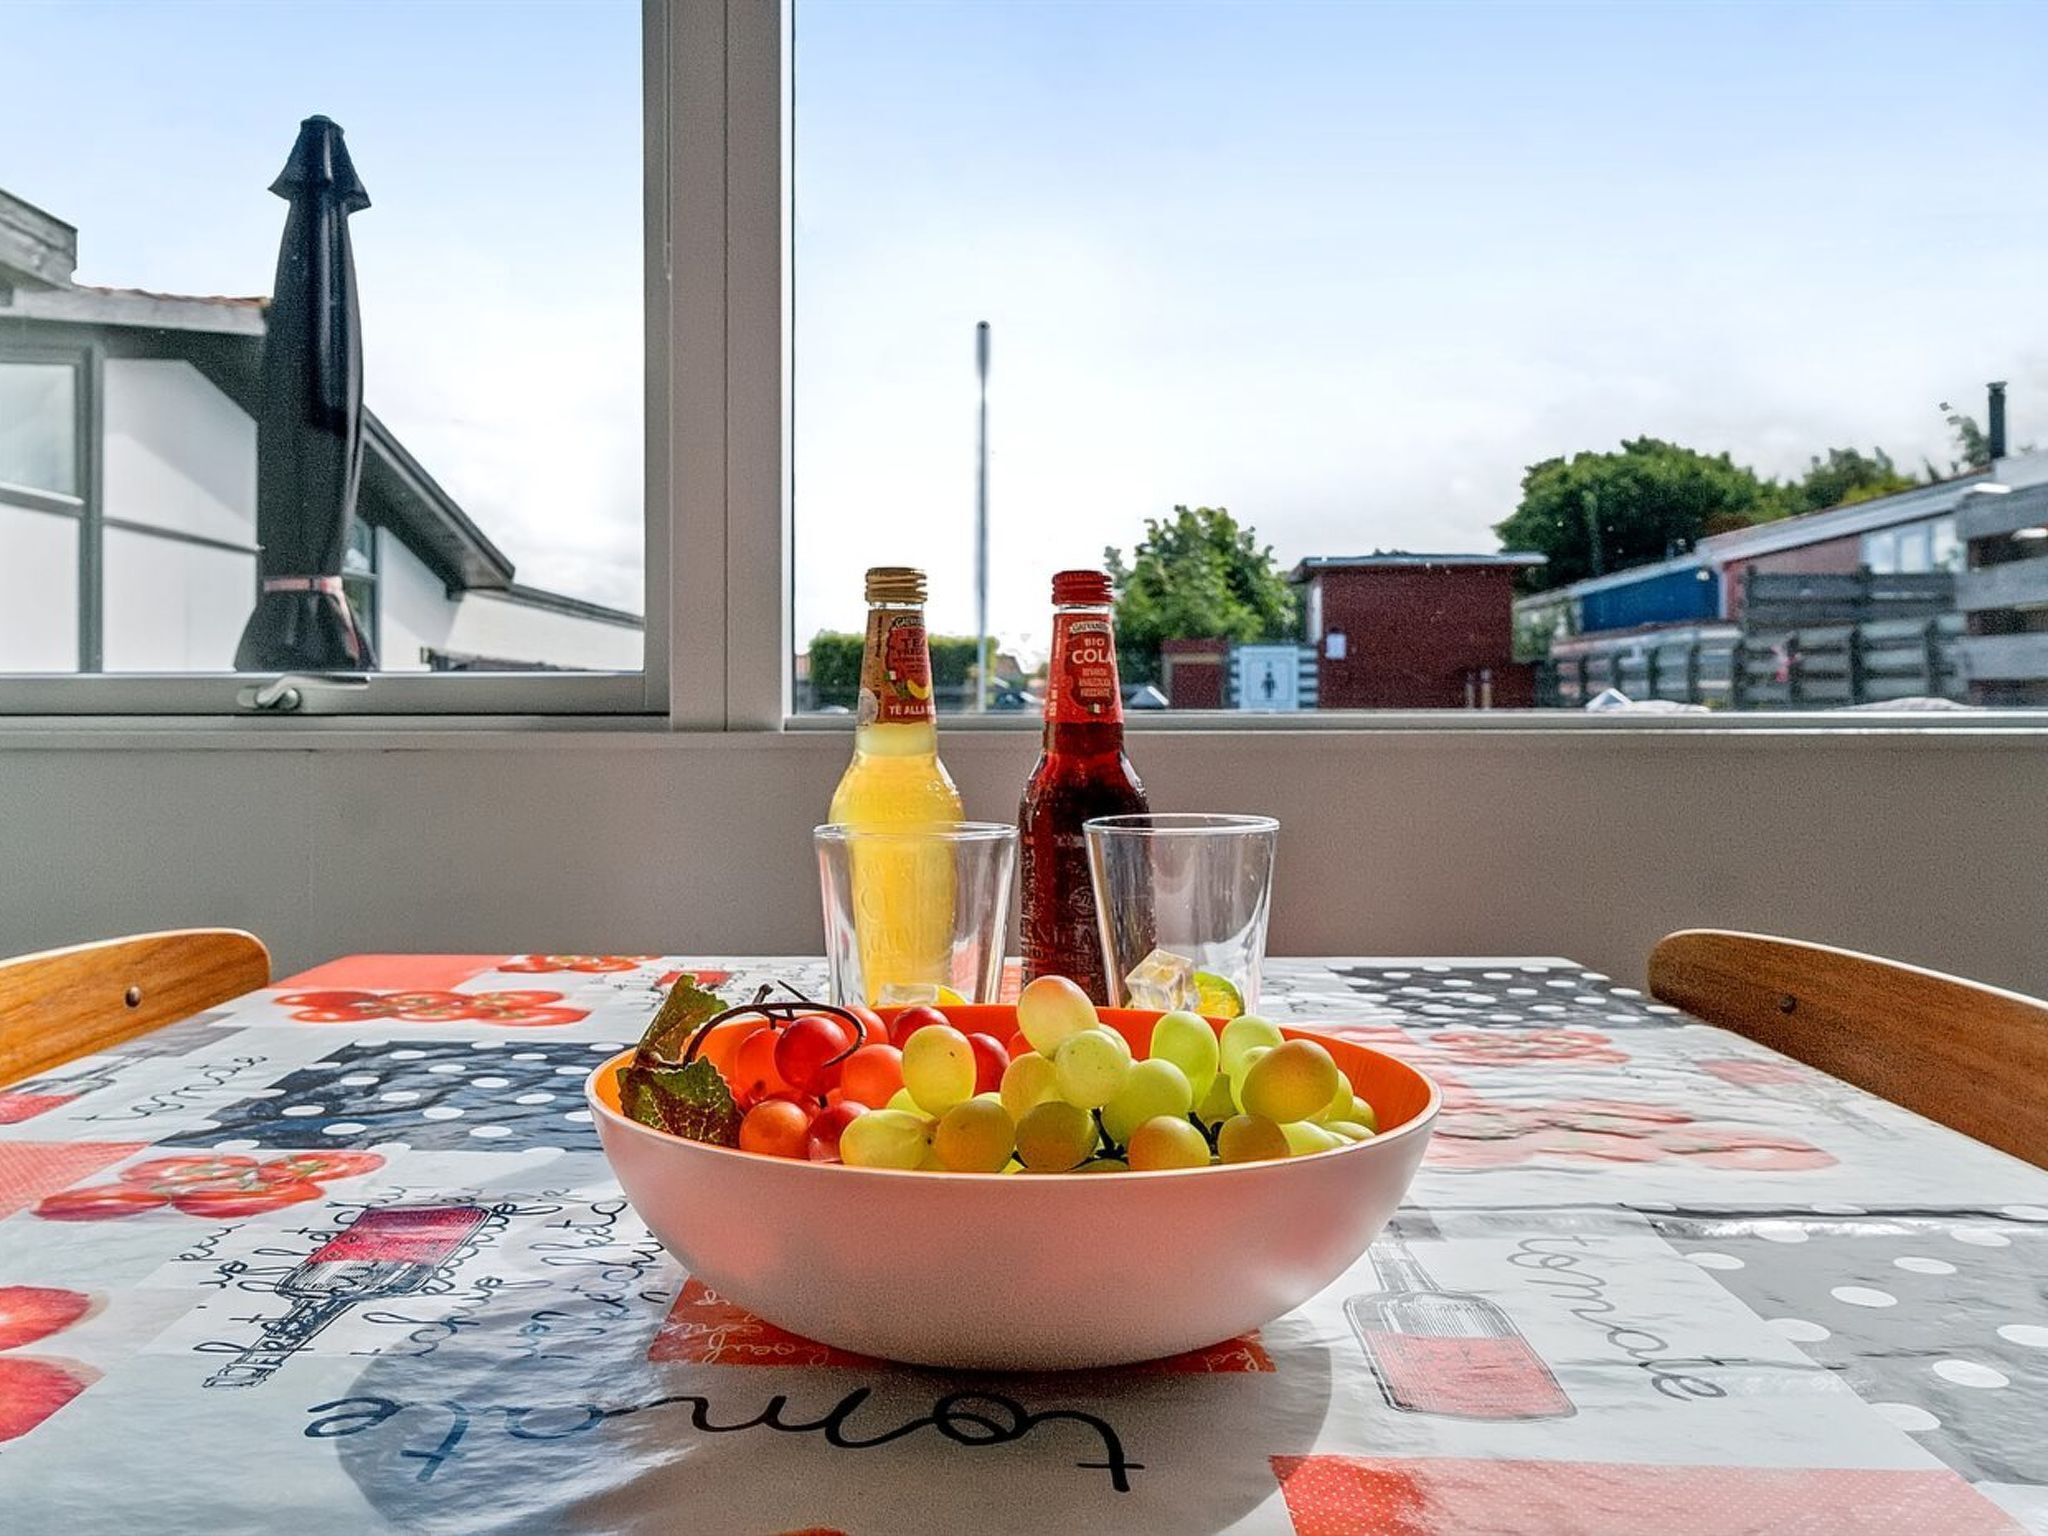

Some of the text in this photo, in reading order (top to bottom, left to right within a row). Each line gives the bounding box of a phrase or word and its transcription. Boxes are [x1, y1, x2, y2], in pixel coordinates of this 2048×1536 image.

[1072, 648, 1114, 665] COLA
[1084, 638, 1105, 647] BIO
[1507, 1234, 1748, 1402] tomate
[304, 1386, 1146, 1494] tomate
